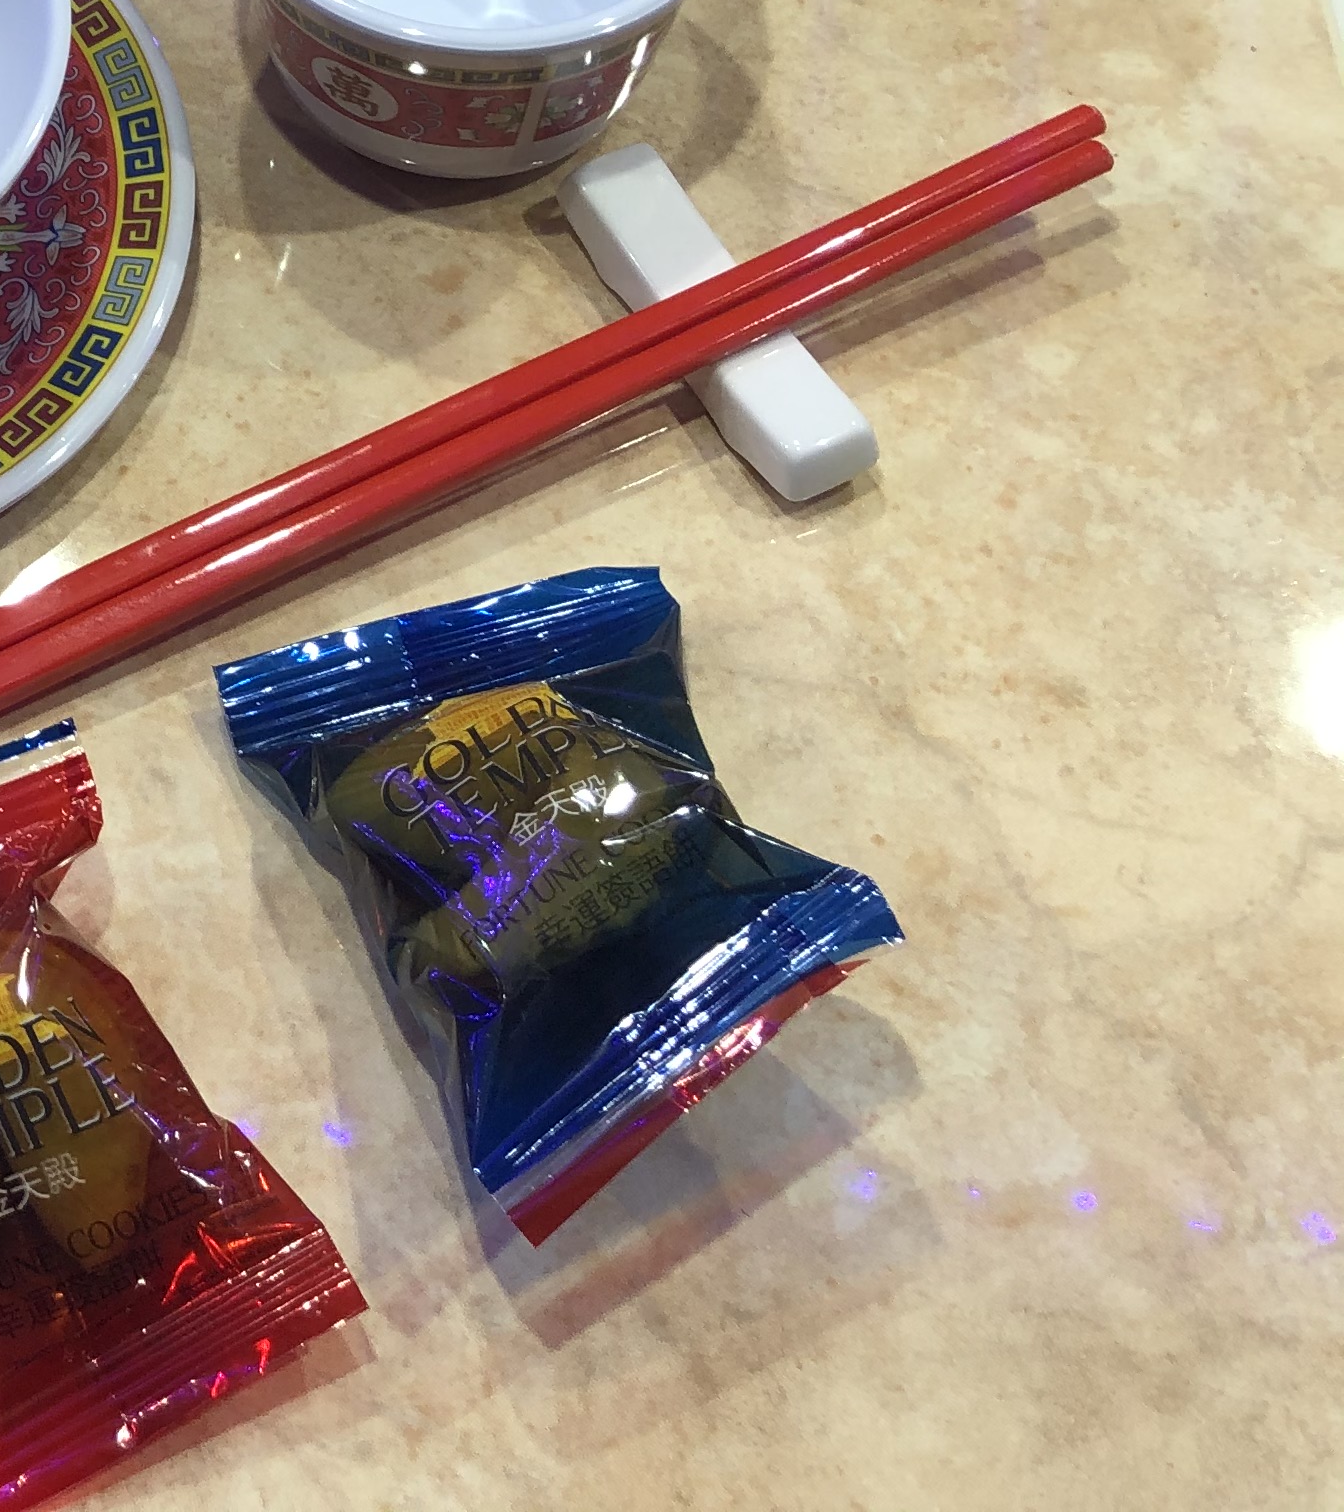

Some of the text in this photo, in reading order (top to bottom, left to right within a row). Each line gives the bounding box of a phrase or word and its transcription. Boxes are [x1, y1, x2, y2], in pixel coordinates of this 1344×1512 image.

[408, 724, 640, 855] TEMPL
[509, 774, 610, 847] 金天殿
[66, 1180, 211, 1260] COOKIES
